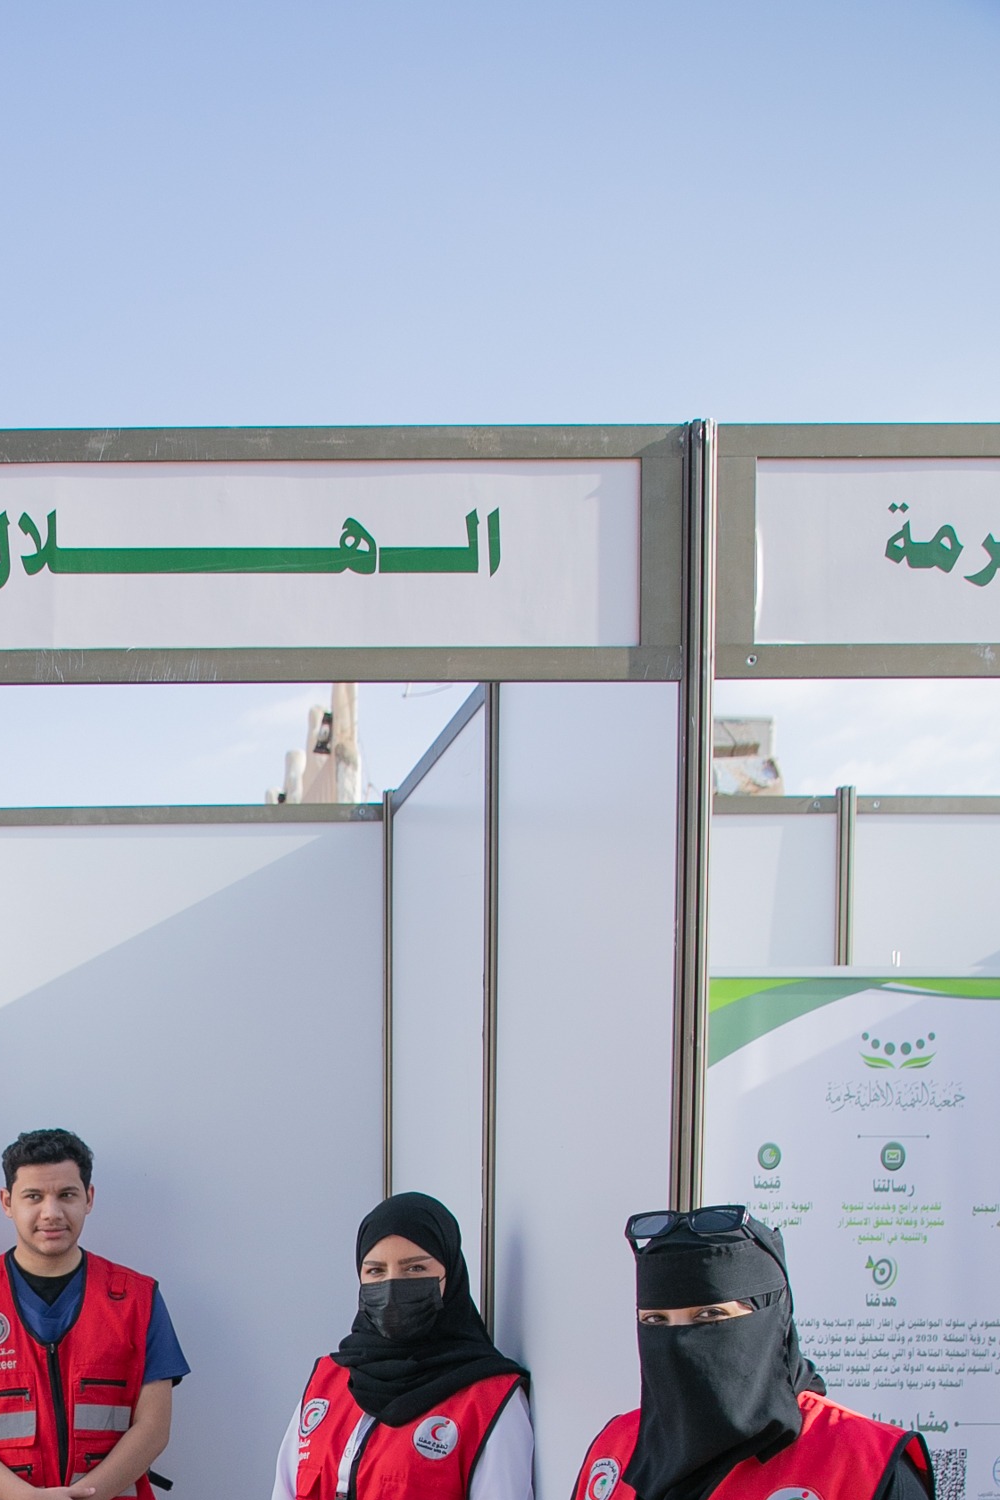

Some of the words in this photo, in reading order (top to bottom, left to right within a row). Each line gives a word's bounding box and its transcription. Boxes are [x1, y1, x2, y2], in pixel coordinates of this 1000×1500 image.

[884, 501, 1000, 588] رمة
[872, 1179, 915, 1197] رسالتنا
[865, 1293, 897, 1308] هدفنا
[915, 1334, 938, 1343] 2030
